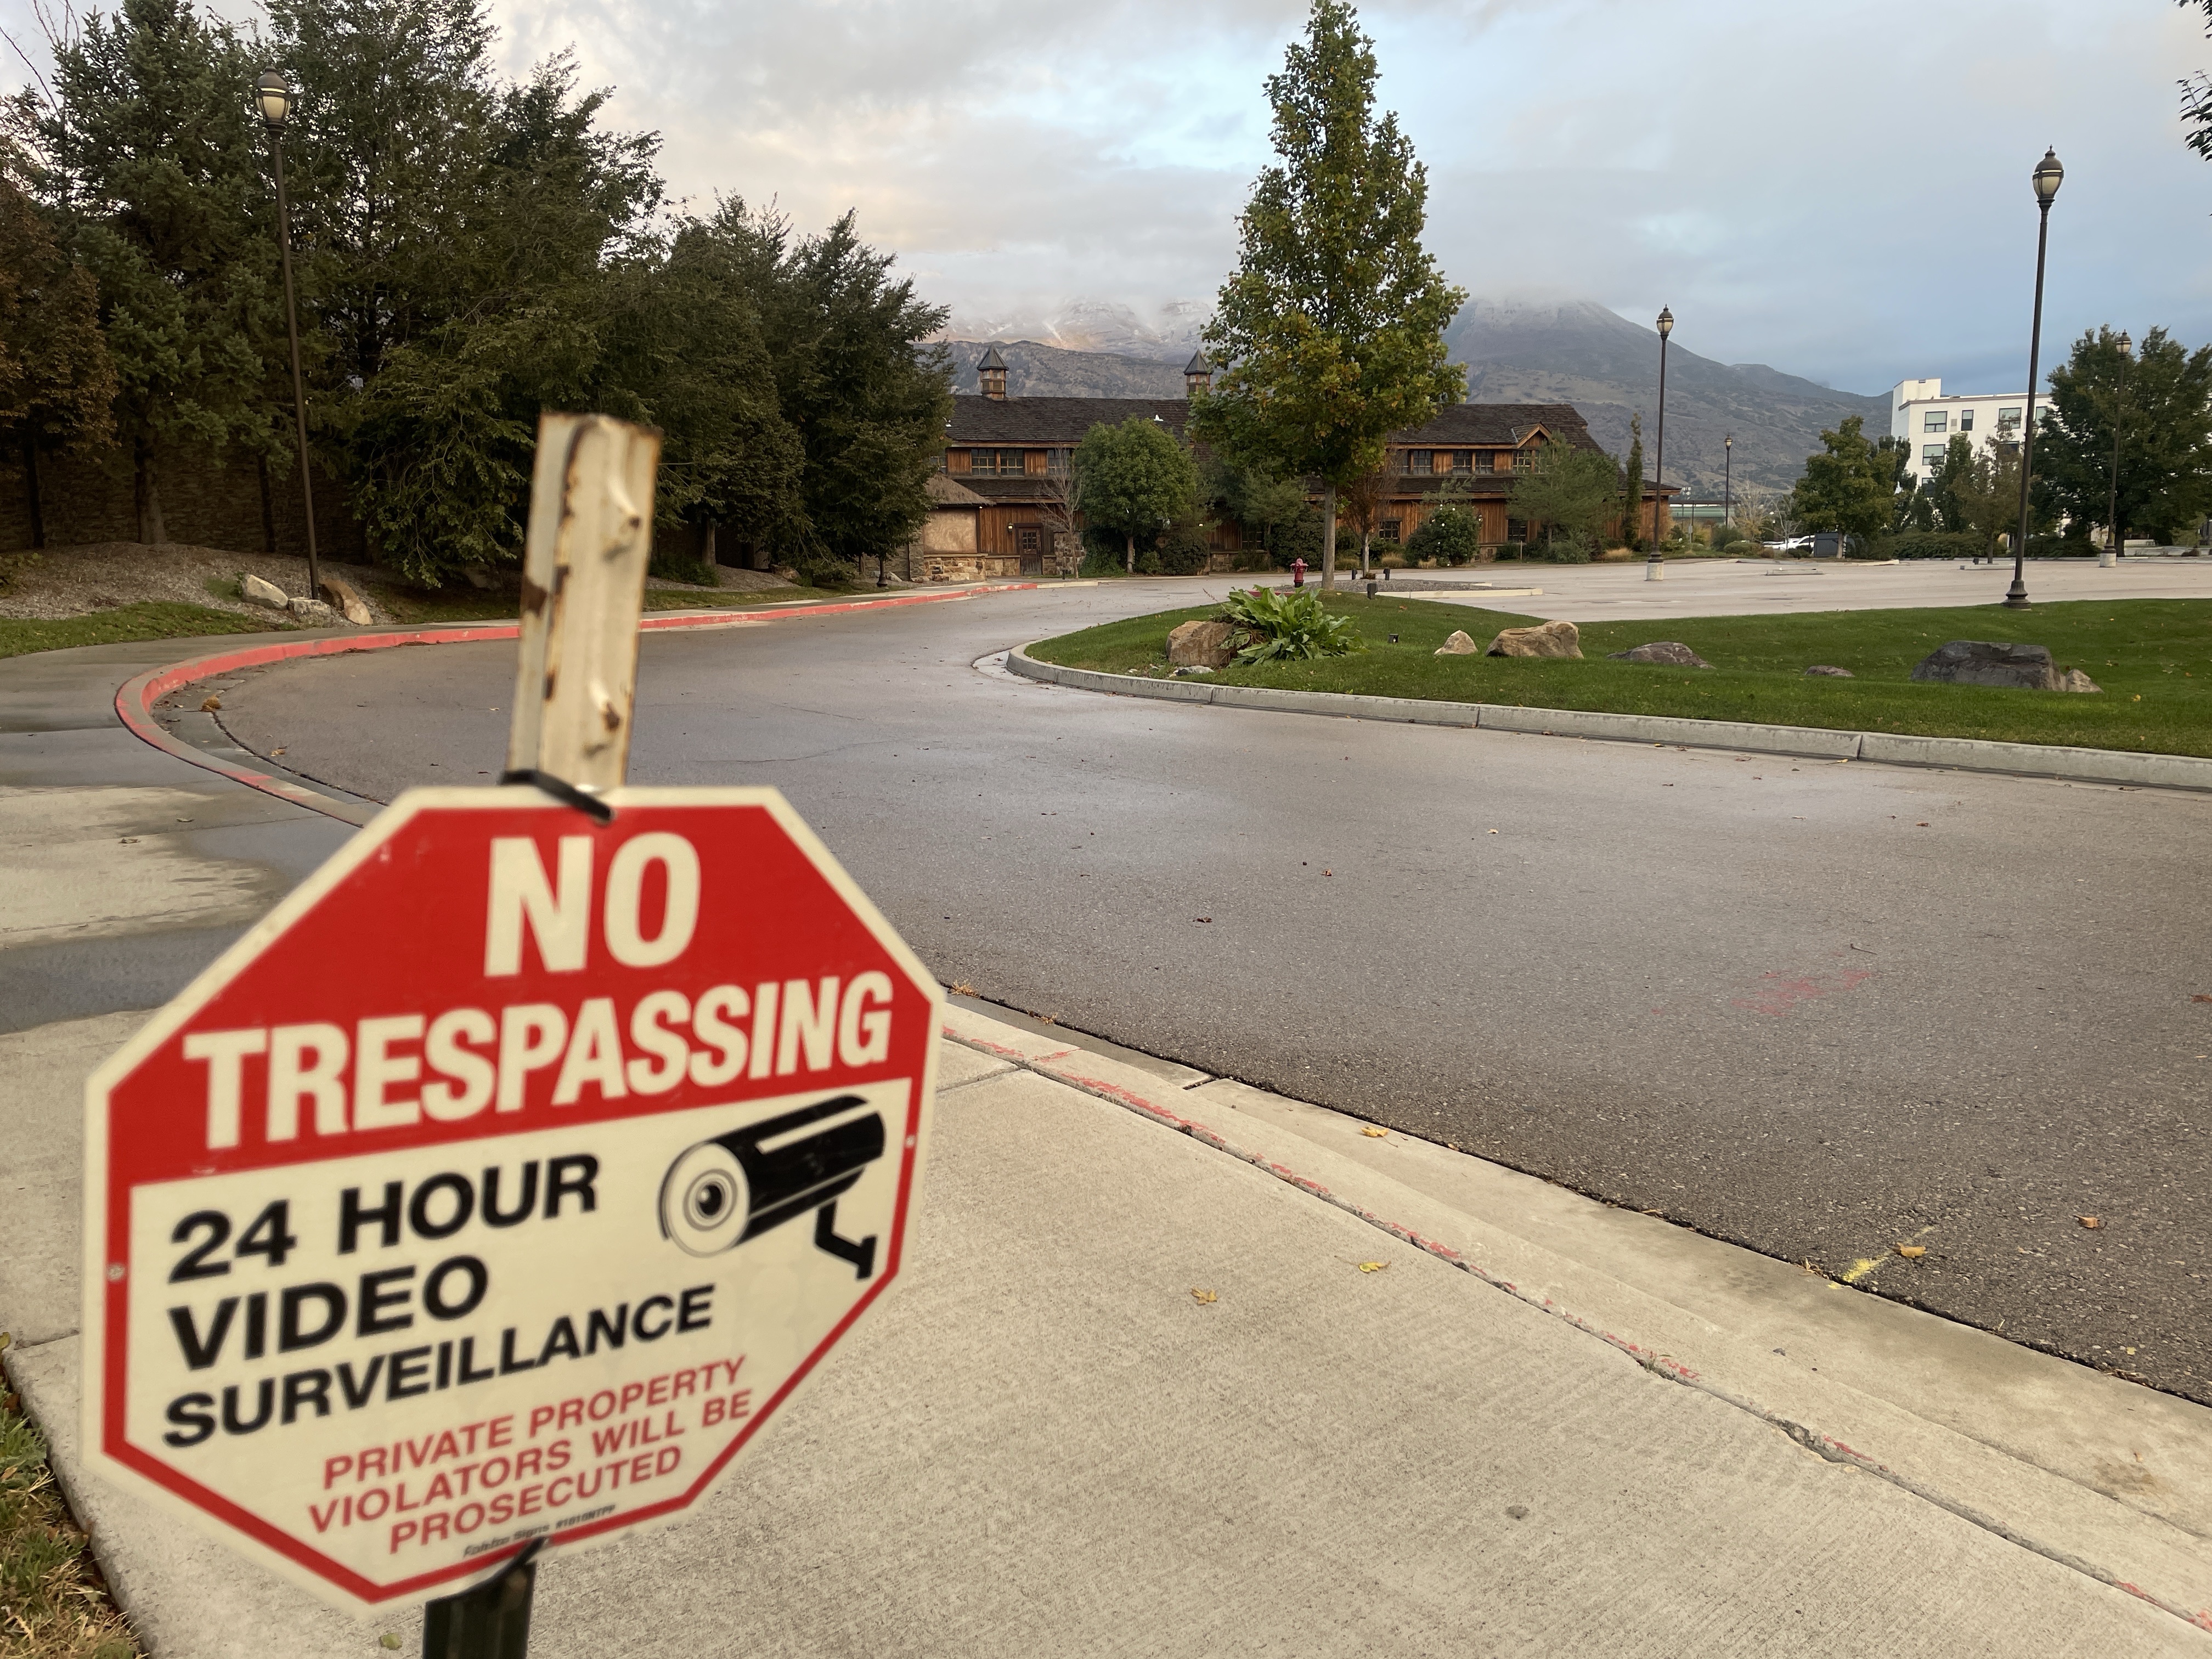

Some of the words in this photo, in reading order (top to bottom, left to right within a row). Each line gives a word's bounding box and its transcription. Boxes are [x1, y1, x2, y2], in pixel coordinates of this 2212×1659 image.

[486, 833, 699, 975] NO
[183, 972, 893, 1149] TRESPASSING
[168, 1200, 297, 1284] 24
[337, 1153, 599, 1255] HOUR
[163, 1284, 715, 1448] SURVEILLANCE
[169, 1255, 488, 1371] VIDEO
[309, 1439, 569, 1532] VIOLATORS
[592, 1412, 684, 1454] WILL
[702, 1391, 751, 1426] BE
[324, 1417, 514, 1488] PRIVATE
[529, 1357, 745, 1437] PROPERTY
[390, 1446, 681, 1552] PROSECUTED
